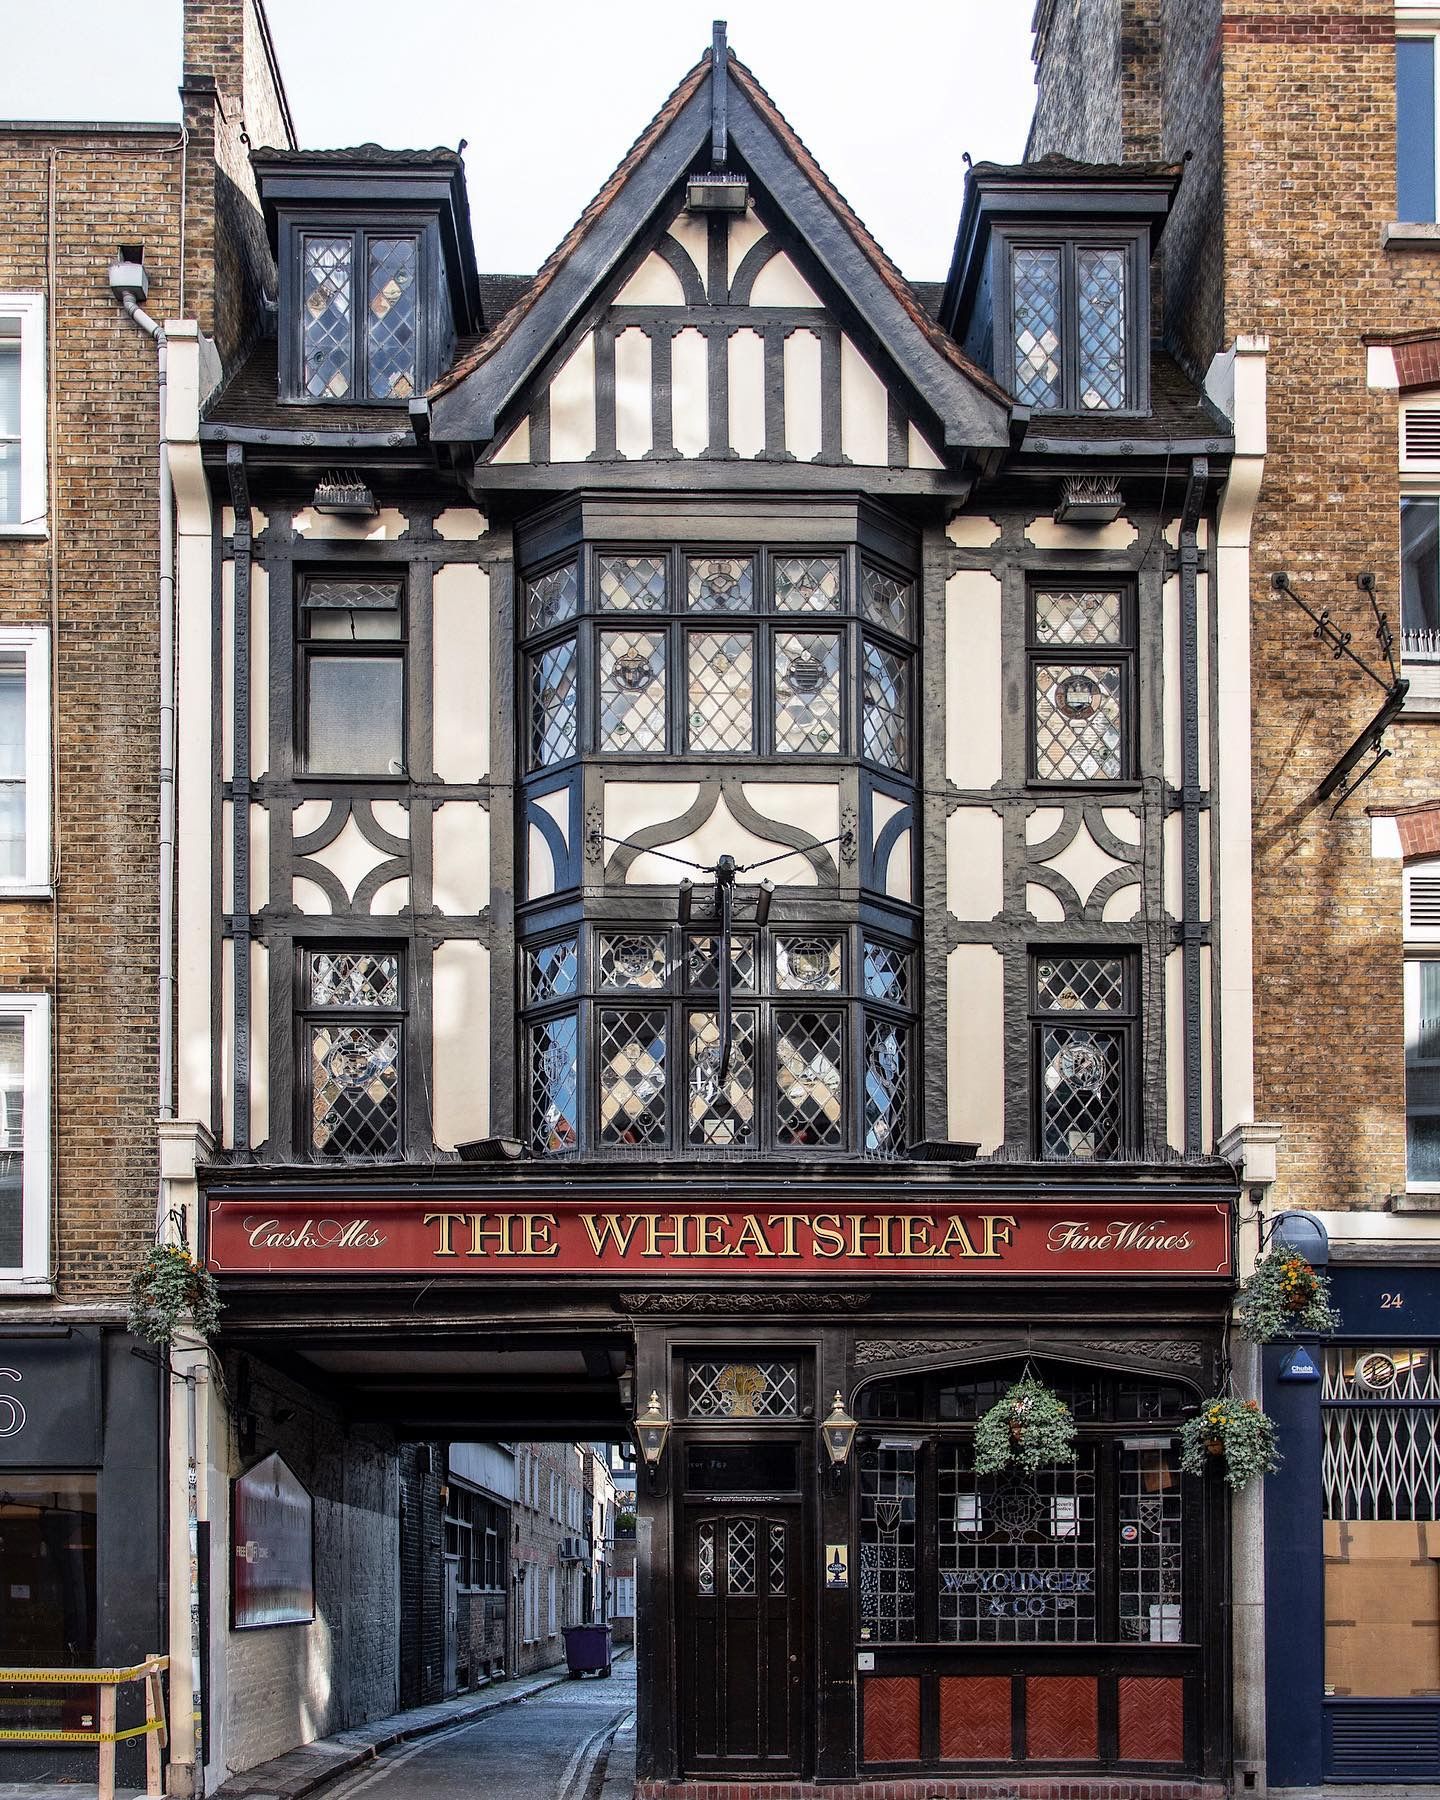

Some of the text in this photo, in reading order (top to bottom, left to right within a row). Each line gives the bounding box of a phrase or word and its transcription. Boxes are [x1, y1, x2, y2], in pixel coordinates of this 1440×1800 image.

[243, 1216, 387, 1248] Cask Ales
[423, 1213, 1019, 1257] THE WHEATSHEAF
[1046, 1220, 1193, 1251] Fine Wines
[1380, 1293, 1404, 1309] 24
[978, 1571, 1091, 1591] YOUNGER
[989, 1597, 1008, 1616] &
